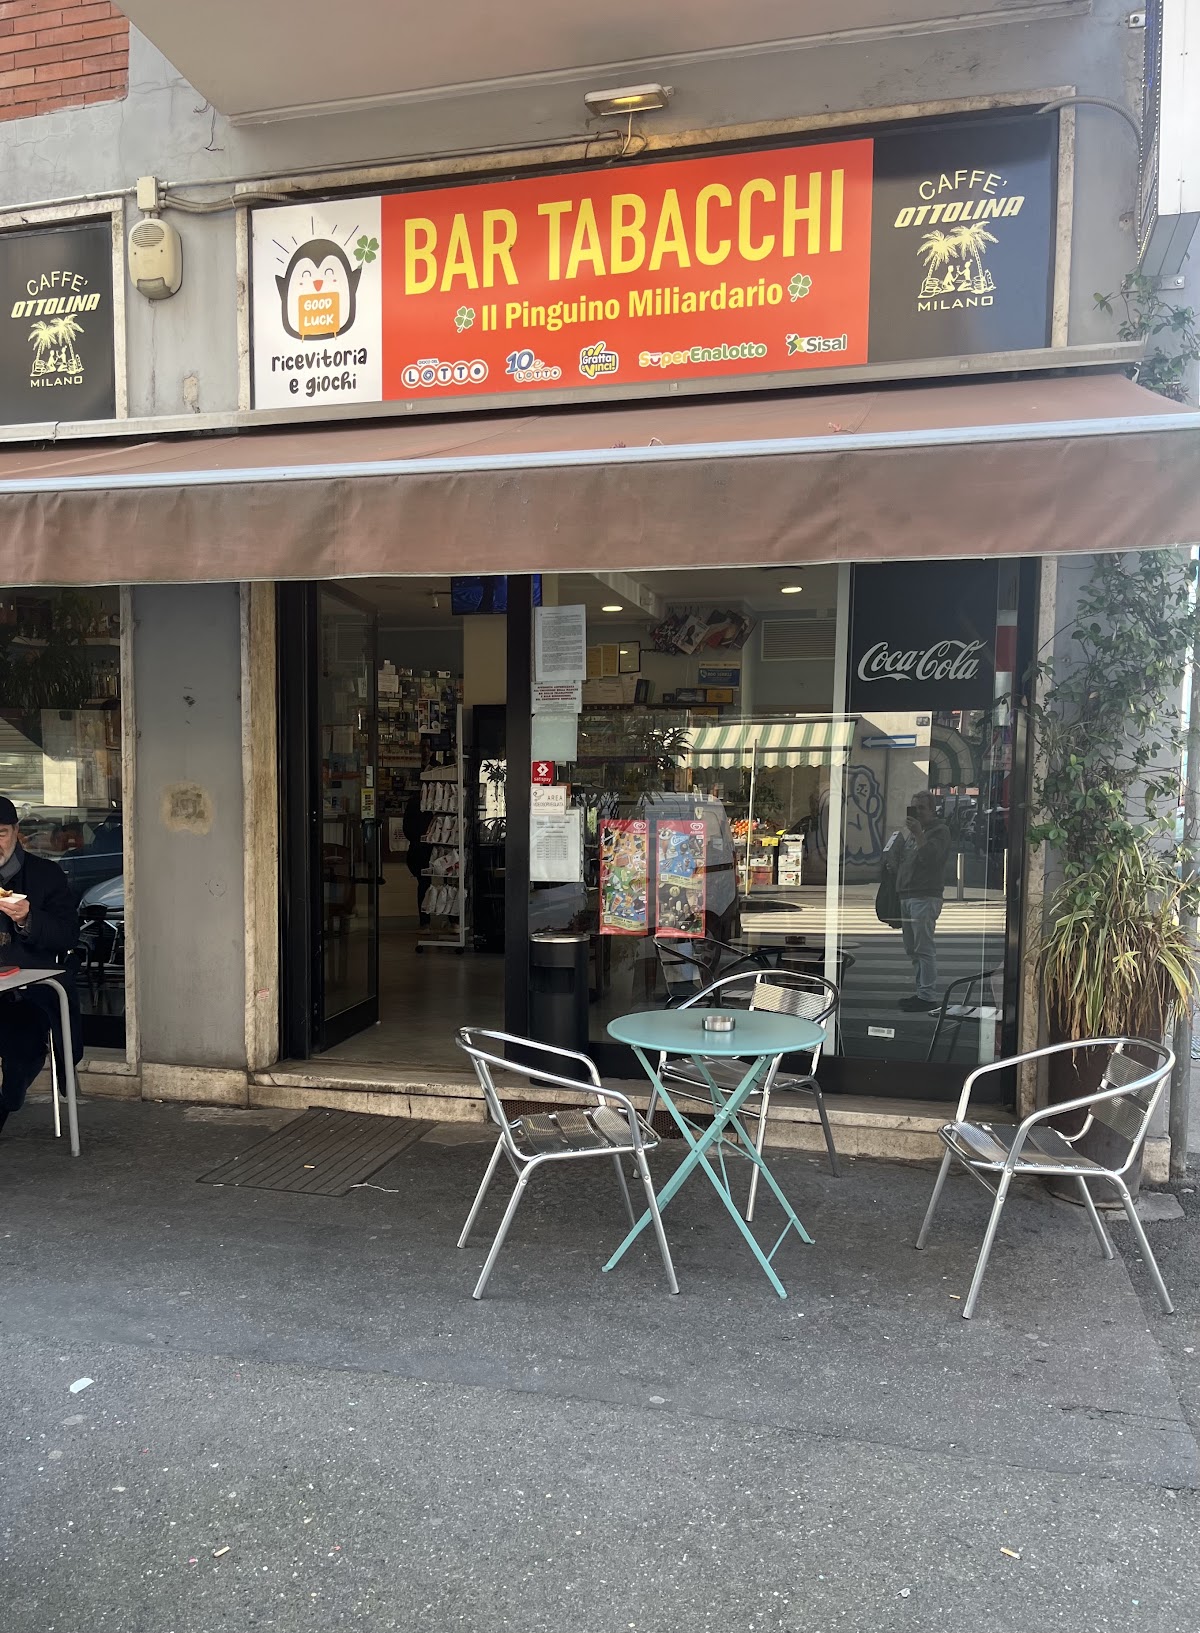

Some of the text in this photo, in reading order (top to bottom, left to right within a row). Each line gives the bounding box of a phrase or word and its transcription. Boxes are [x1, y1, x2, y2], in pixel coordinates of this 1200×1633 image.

[894, 196, 1025, 228] OTTOLINA
[404, 169, 845, 295] BAR TABACCHI
[10, 293, 101, 318] OTTOLINA
[303, 298, 332, 311] GOOD
[481, 278, 783, 331] Il Pinguino Miliardario
[917, 296, 994, 312] MILANO
[303, 314, 334, 327] LUCK
[639, 343, 766, 368] SuperEnalotto
[806, 335, 848, 352] Sisal
[271, 347, 368, 372] ricevitoria
[506, 350, 534, 373] 10
[582, 354, 612, 365] Gratta
[30, 376, 83, 387] MILANO
[289, 371, 357, 397] e giochi
[403, 361, 487, 386] LOTTO
[515, 367, 561, 382] LOTTO
[857, 640, 988, 682] Coca-Cola
